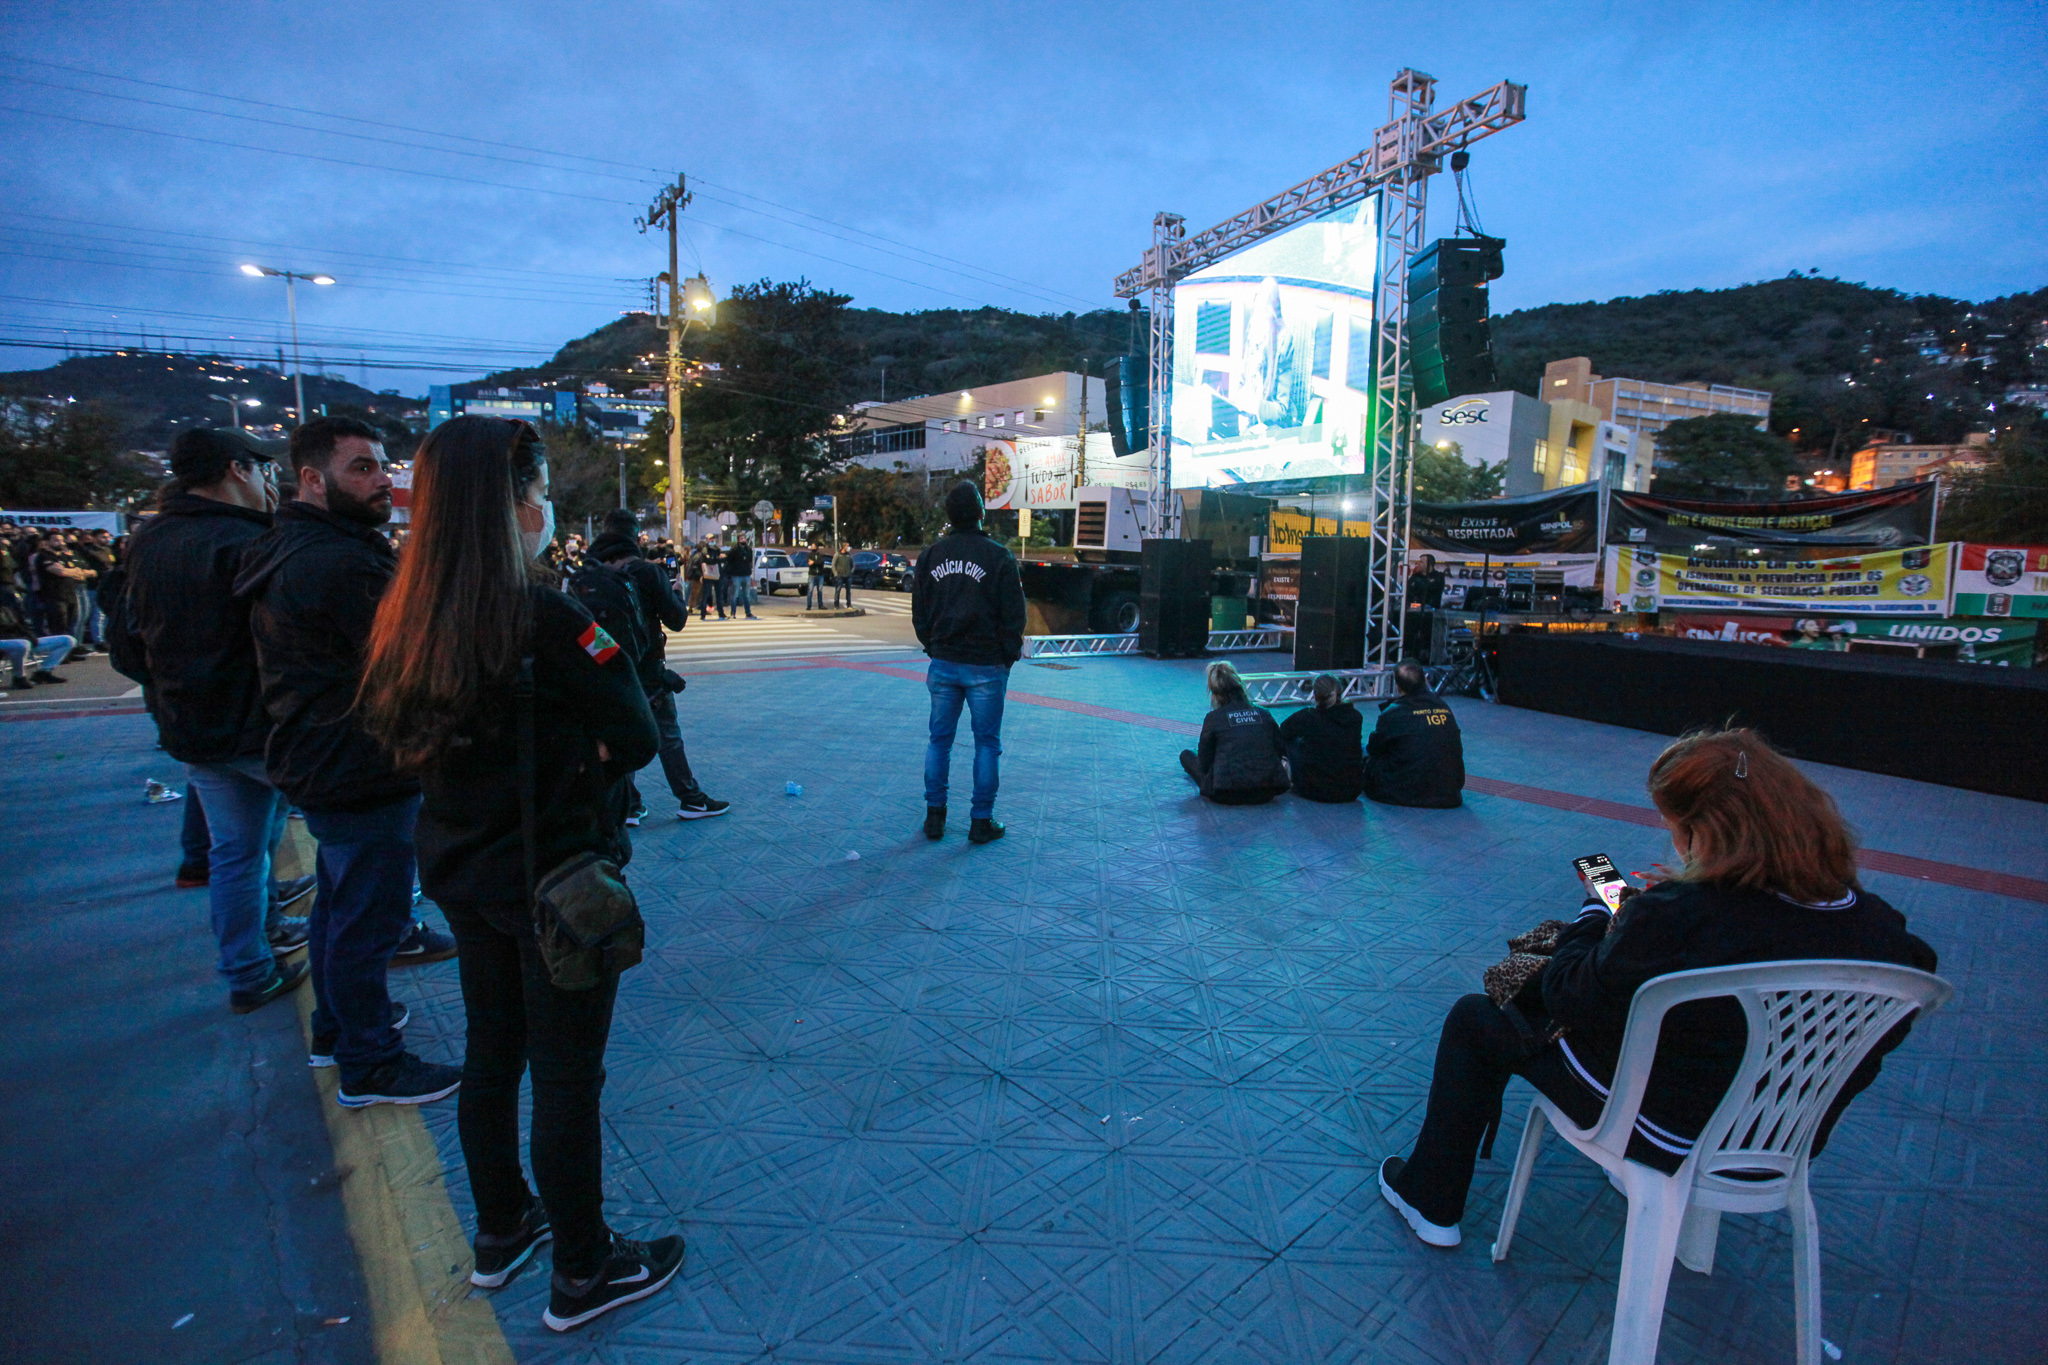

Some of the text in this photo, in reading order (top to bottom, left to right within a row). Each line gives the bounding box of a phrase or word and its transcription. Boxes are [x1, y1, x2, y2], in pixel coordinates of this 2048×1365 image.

[1044, 451, 1067, 467] AMOR
[1031, 470, 1053, 485] TUDO
[1030, 482, 1067, 505] SABOR
[18, 515, 72, 525] PENAIS
[1461, 517, 1499, 527] EXISTE
[1540, 521, 1573, 531] SINPOL
[1667, 513, 1690, 526] NÃO
[931, 558, 987, 583] POLÍCIA CIVIL
[1459, 568, 1507, 580] REFO
[1685, 570, 1734, 582] ISONOMIA
[1738, 573, 1752, 582] NA
[1756, 572, 1827, 583] PREVIDÊNCIA
[1831, 571, 1862, 582] PARA
[1677, 581, 1739, 594] OPERADORES
[1744, 585, 1757, 595] DE
[1888, 624, 2003, 643] UNIDOS
[1235, 716, 1256, 724] CIVIL
[1426, 714, 1447, 726] IGP
